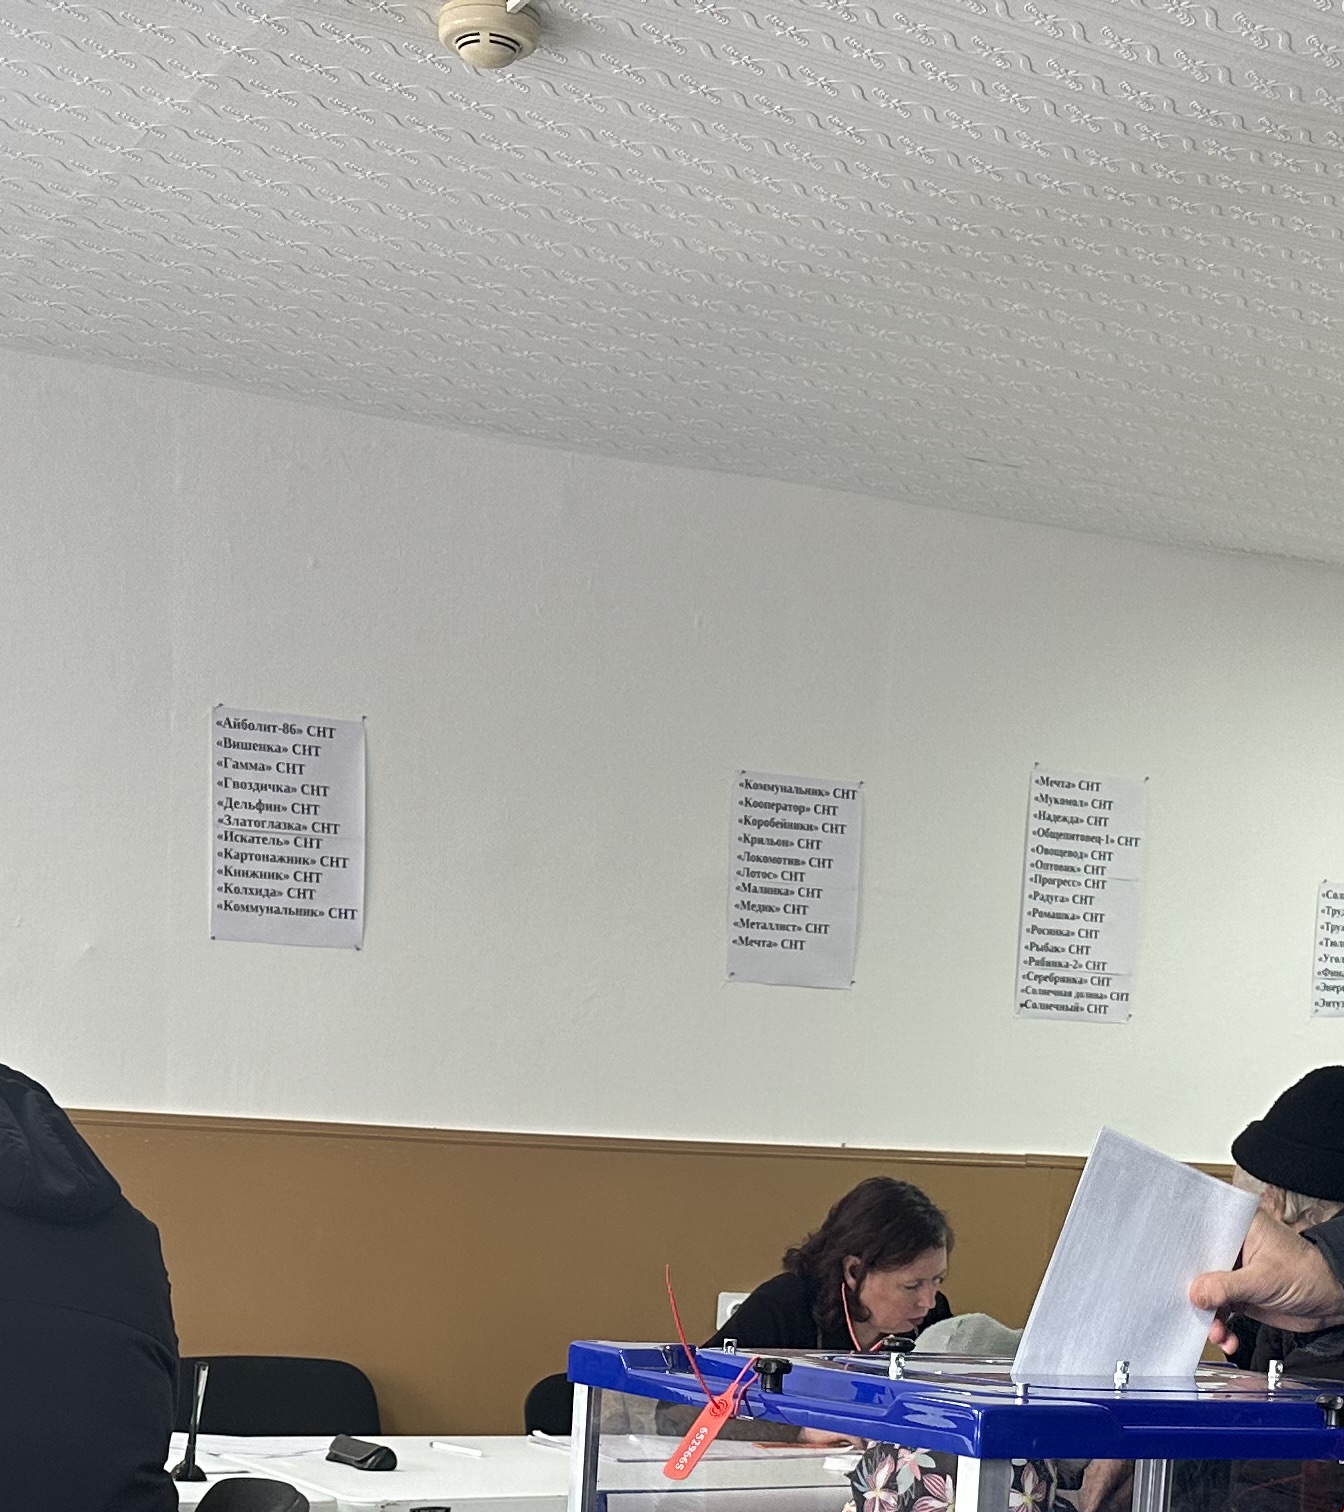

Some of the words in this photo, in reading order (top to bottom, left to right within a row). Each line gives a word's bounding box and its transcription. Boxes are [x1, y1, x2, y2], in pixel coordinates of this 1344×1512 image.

[215, 716, 303, 735] «Айболит-86»
[306, 725, 336, 739] СНТ
[216, 736, 288, 753] «Вишенка»
[291, 743, 321, 757] СНТ
[216, 756, 272, 771] «Гамма»
[275, 761, 305, 775] СНТ
[216, 776, 297, 793] «Гвоздичка»
[300, 783, 330, 797] СНТ
[738, 778, 830, 797] «Коммунальник»
[832, 787, 858, 800] СНТ
[1078, 780, 1102, 792] СНТ
[216, 796, 287, 814] «Дельфин»
[290, 802, 320, 816] СНТ
[738, 796, 811, 816] «Кооператор»
[813, 803, 839, 816] СНТ
[1090, 798, 1113, 811] СНТ
[217, 814, 308, 831] «Златоглазка»
[311, 821, 340, 835] СНТ
[821, 822, 847, 835] СНТ
[1086, 815, 1109, 827] СНТ
[216, 830, 290, 846] «Искатель»
[293, 836, 323, 849] СНТ
[737, 832, 795, 847] «Крильон»
[796, 838, 823, 850] СНТ
[1116, 835, 1141, 847] СНТ
[216, 847, 316, 865] «Картонажник»
[319, 855, 349, 869] СНТ
[736, 850, 806, 866] «Локомотив»
[808, 856, 834, 869] СНТ
[1090, 849, 1114, 862] СНТ
[216, 864, 290, 881] «Книжник»
[293, 870, 323, 884] СНТ
[735, 866, 778, 880] «Лотос»
[780, 870, 806, 882] СНТ
[1083, 864, 1107, 876] СНТ
[216, 882, 283, 899] «Колхида»
[286, 887, 316, 900] СНТ
[735, 881, 795, 896] «Малинка»
[797, 886, 823, 899] СНТ
[1084, 878, 1107, 890] СНТ
[734, 899, 781, 913] «Медик»
[782, 903, 809, 915] СНТ
[1071, 894, 1095, 905] СНТ
[216, 899, 325, 917] «Коммунальник»
[328, 907, 358, 920] СНТ
[1082, 911, 1105, 923] СНТ
[732, 917, 802, 932] «Металлист»
[804, 922, 830, 935] СНТ
[1077, 928, 1100, 939] СНТ
[731, 935, 778, 948] «Мечта»
[780, 938, 806, 951] СНТ
[1068, 944, 1091, 955] СНТ
[1085, 960, 1107, 972] СНТ
[1090, 975, 1112, 987] СНТ
[1109, 991, 1129, 1002] СНТ
[1086, 1003, 1109, 1015] СНТ
